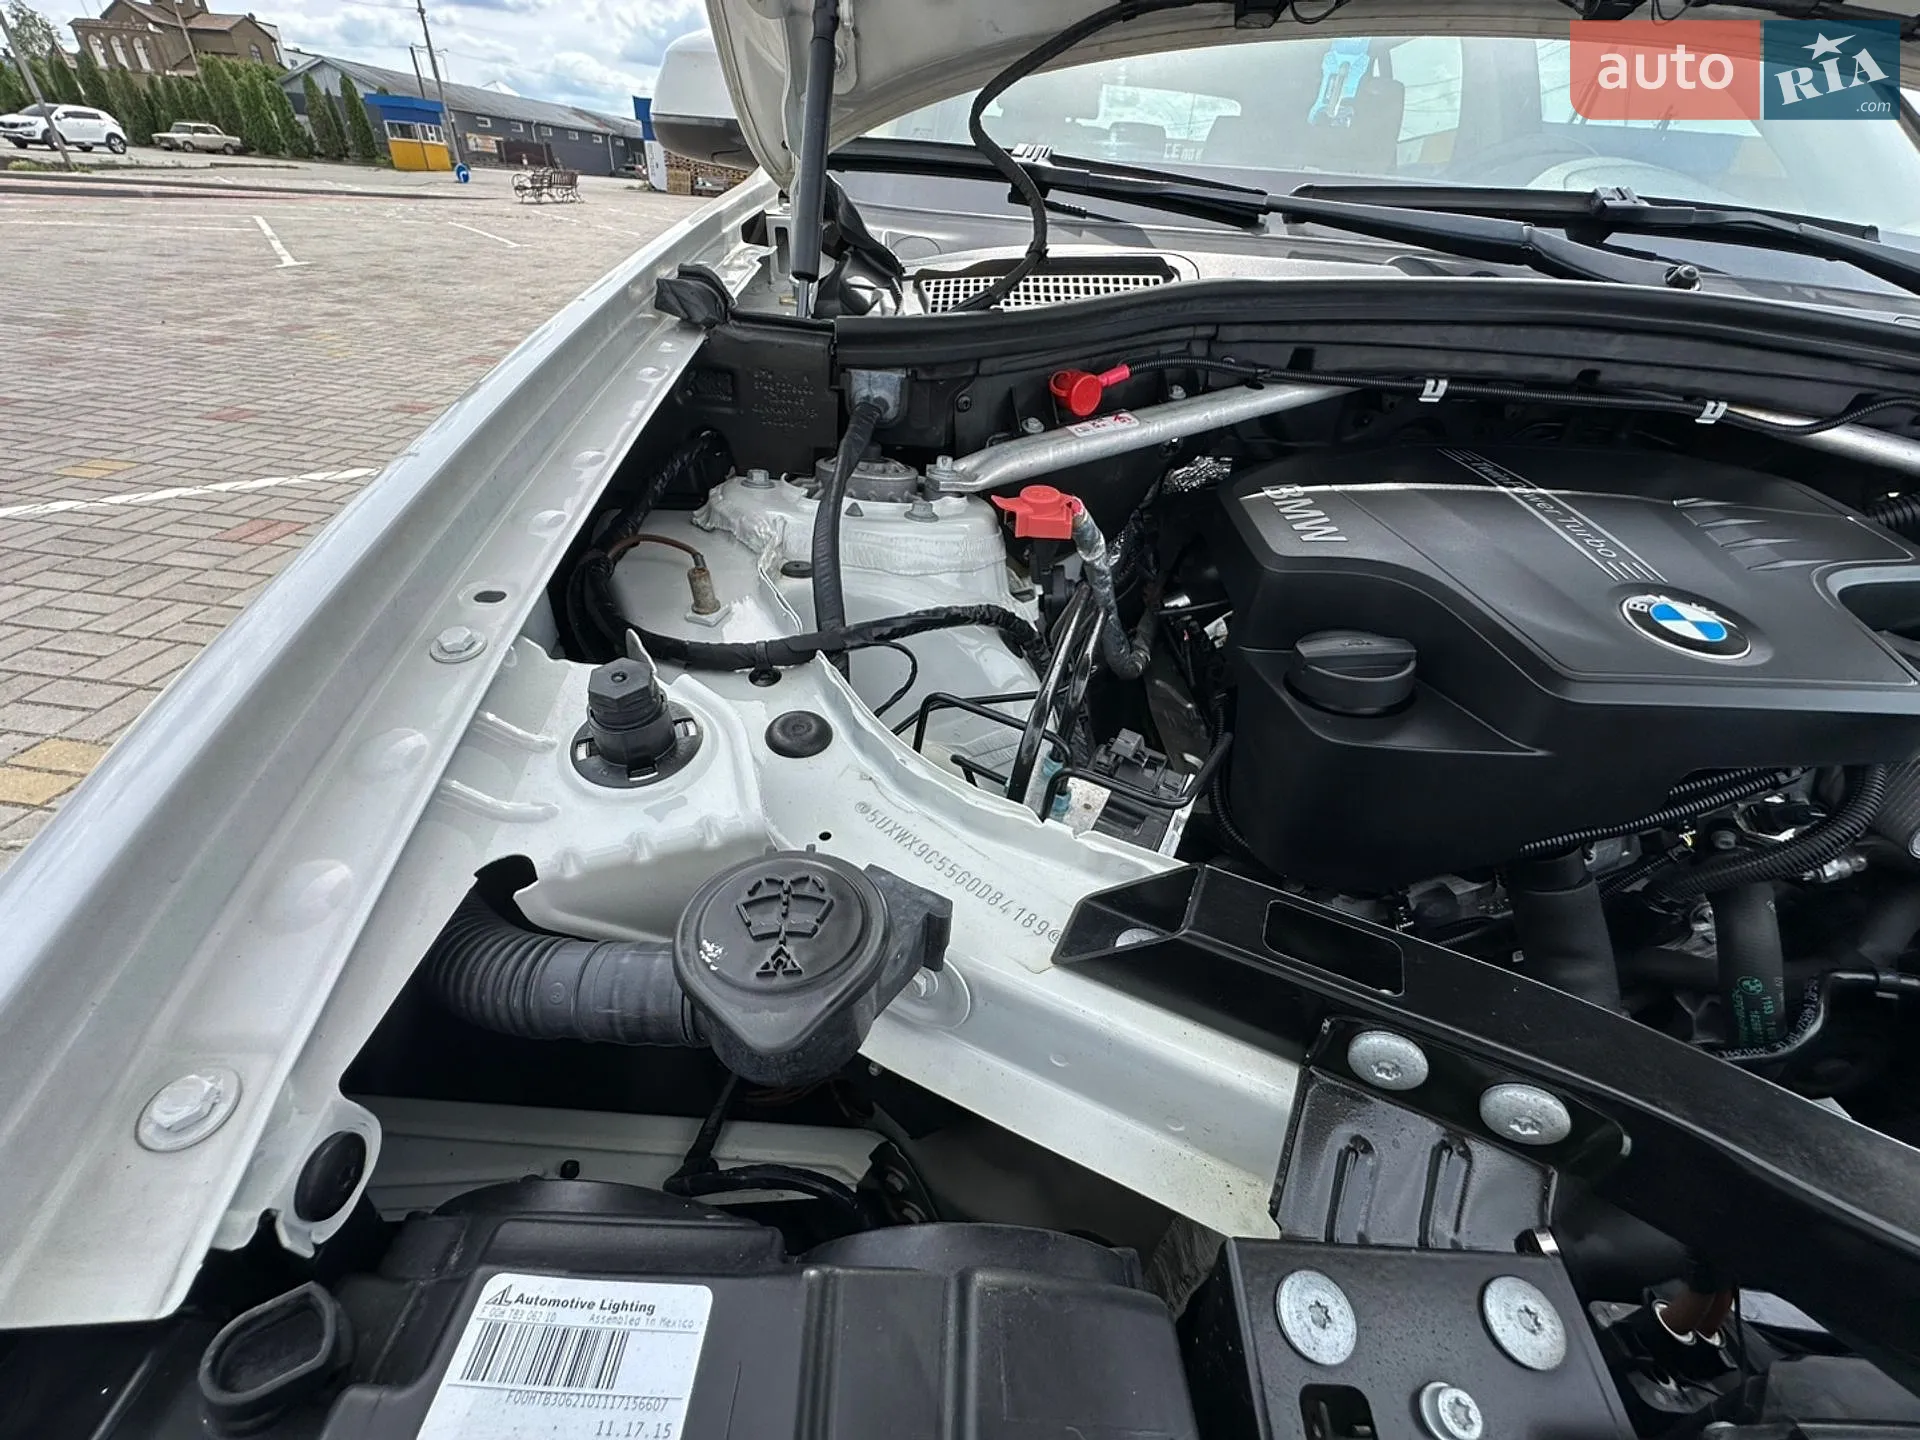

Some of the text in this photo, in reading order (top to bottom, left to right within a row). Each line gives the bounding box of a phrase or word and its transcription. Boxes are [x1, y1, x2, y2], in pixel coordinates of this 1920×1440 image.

[1261, 484, 1348, 542] BMW
[1558, 516, 1617, 559] Turbo
[514, 1292, 597, 1311] Automotive
[600, 1298, 656, 1316] Lighting
[589, 1313, 694, 1329] Assembled in Mexico
[595, 1420, 672, 1439] 11.17.15
